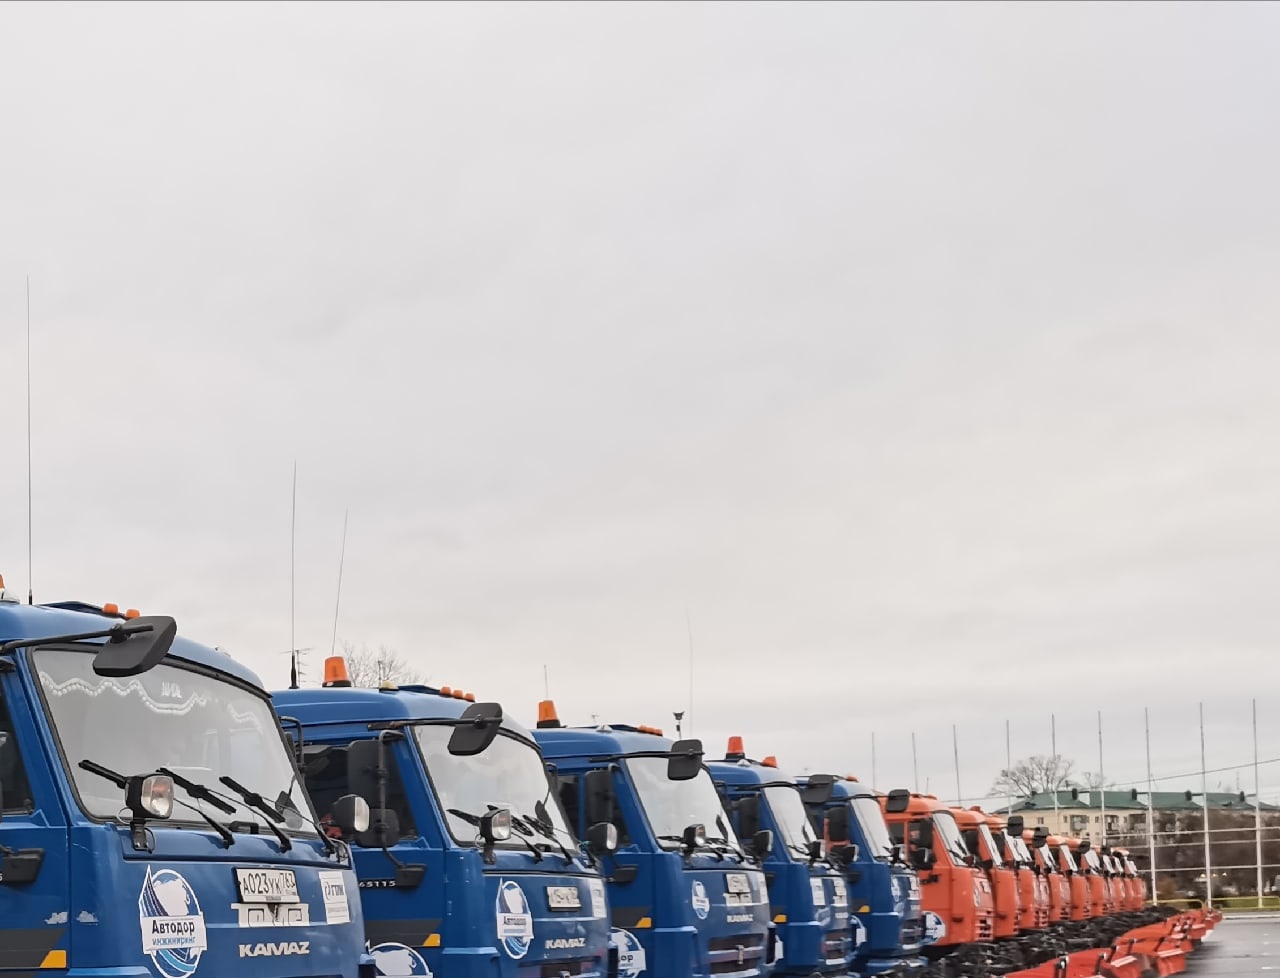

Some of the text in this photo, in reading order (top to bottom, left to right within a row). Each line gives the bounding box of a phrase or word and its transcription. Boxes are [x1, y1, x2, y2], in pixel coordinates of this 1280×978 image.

[152, 920, 195, 935] Автодор
[239, 941, 310, 958] KAMAZ
[545, 938, 586, 949] KAMAZ
